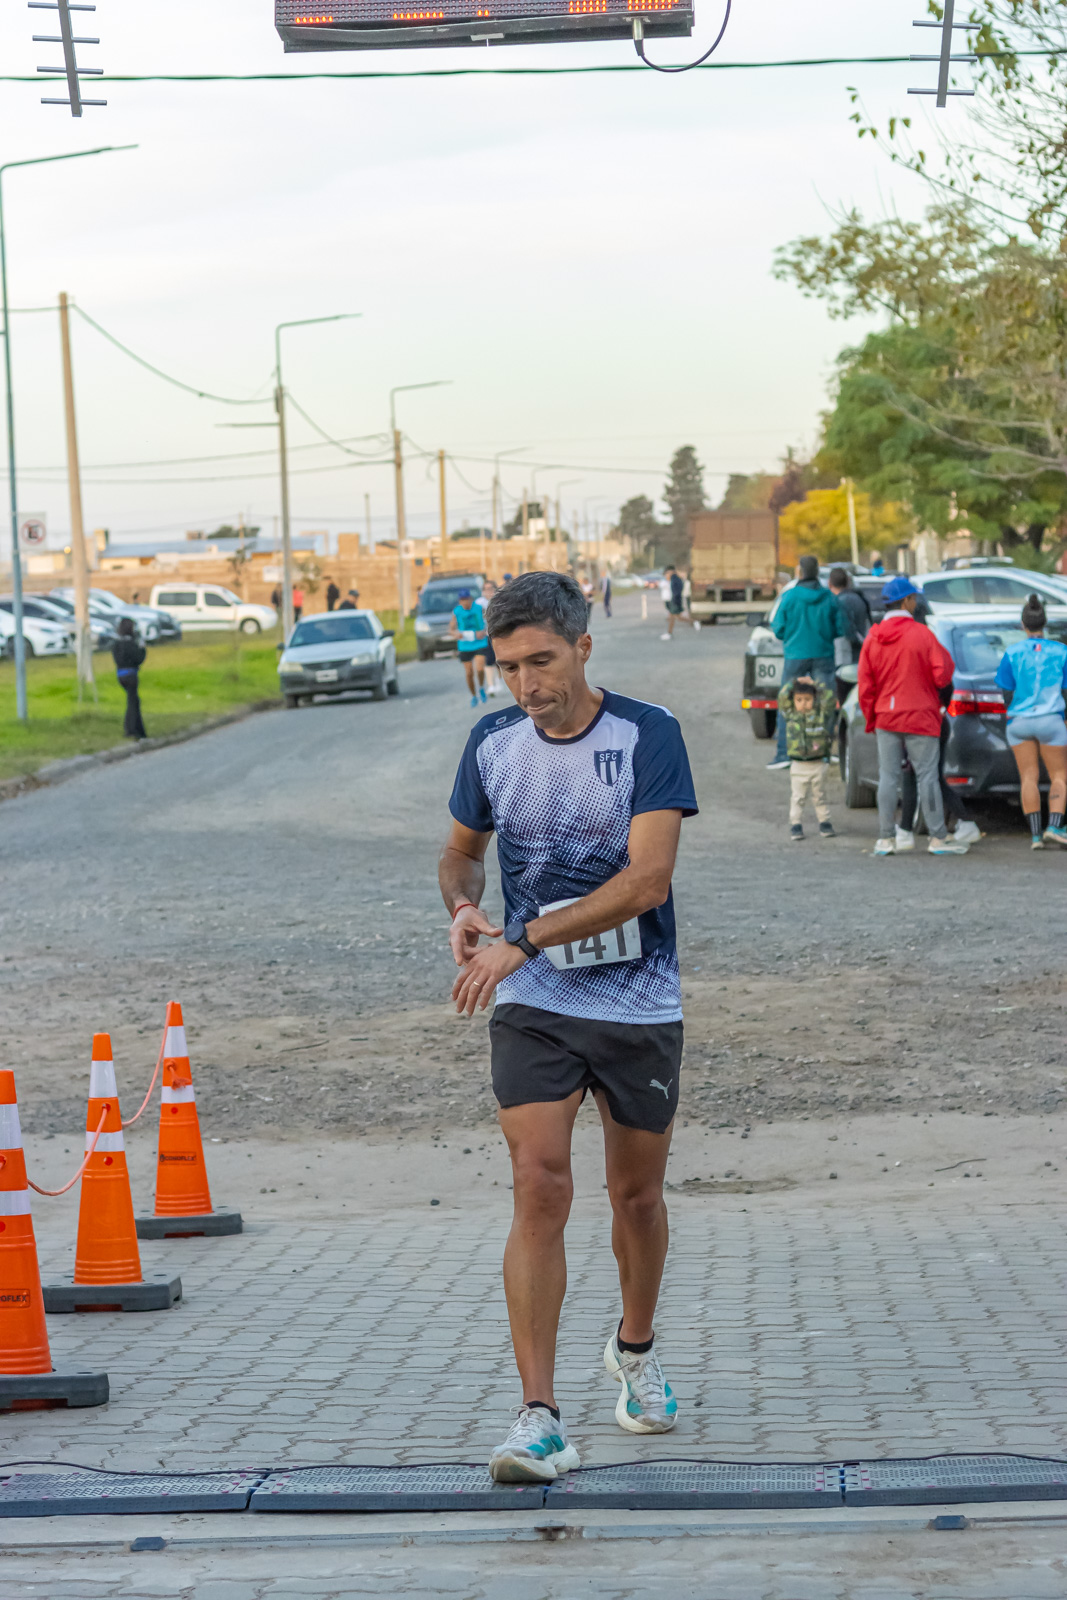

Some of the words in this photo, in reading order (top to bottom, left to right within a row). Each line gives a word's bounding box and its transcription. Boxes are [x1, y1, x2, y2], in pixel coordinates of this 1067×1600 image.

[758, 664, 776, 678] 80
[599, 752, 617, 762] SFC
[563, 924, 627, 965] 141
